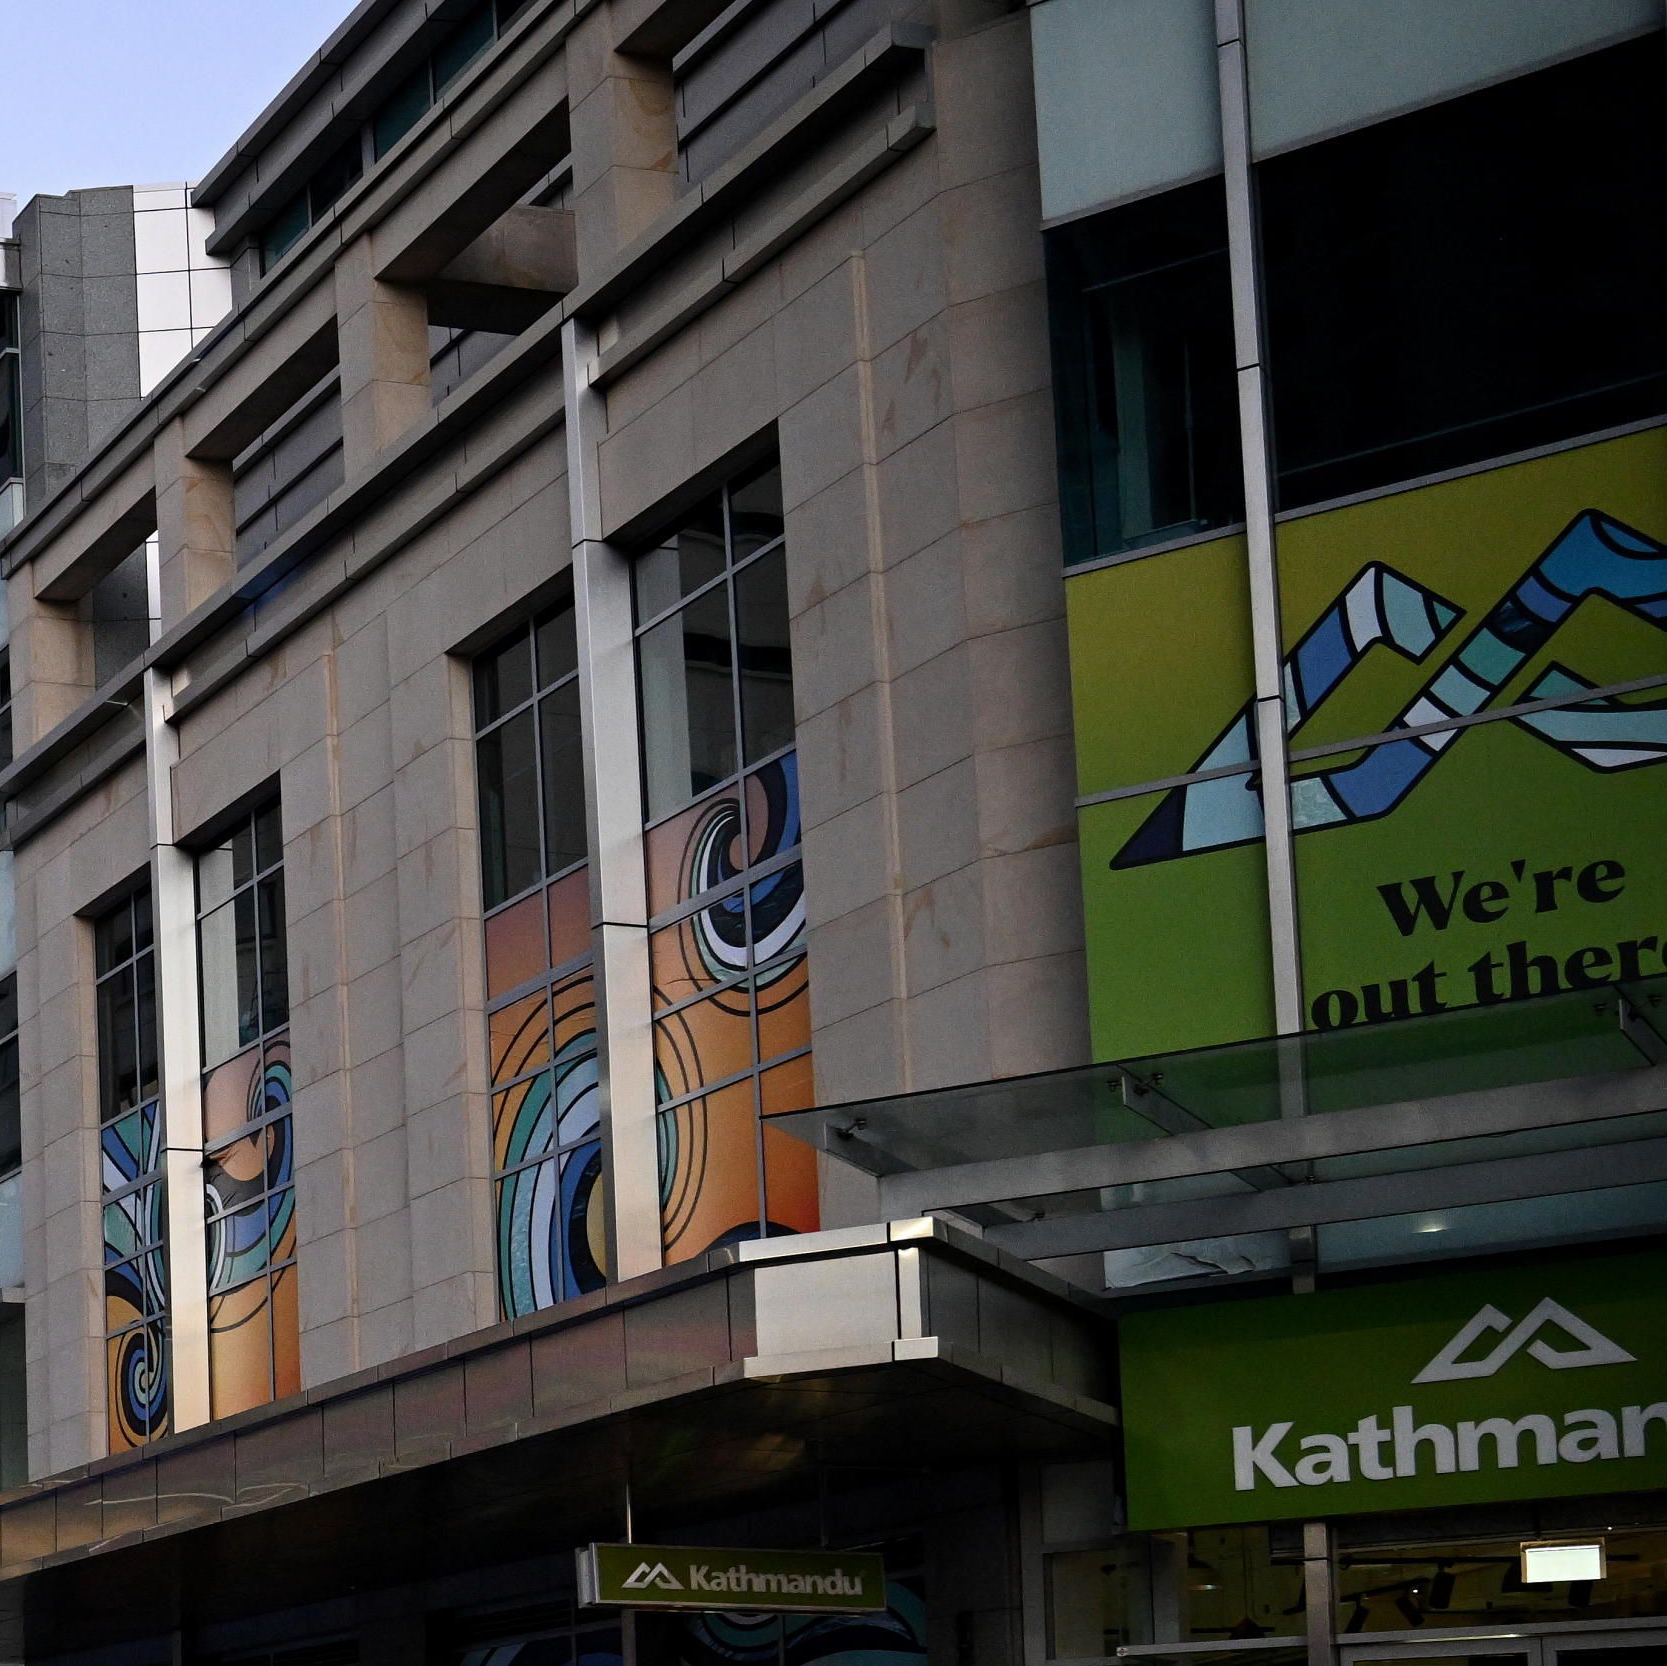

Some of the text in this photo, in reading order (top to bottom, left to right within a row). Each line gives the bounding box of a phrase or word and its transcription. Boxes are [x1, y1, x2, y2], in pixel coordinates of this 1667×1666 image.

[1376, 859, 1626, 937] We're
[1310, 936, 1667, 1029] out ther
[1232, 1402, 1667, 1491] Kathman
[689, 1565, 863, 1595] Kathmandu
